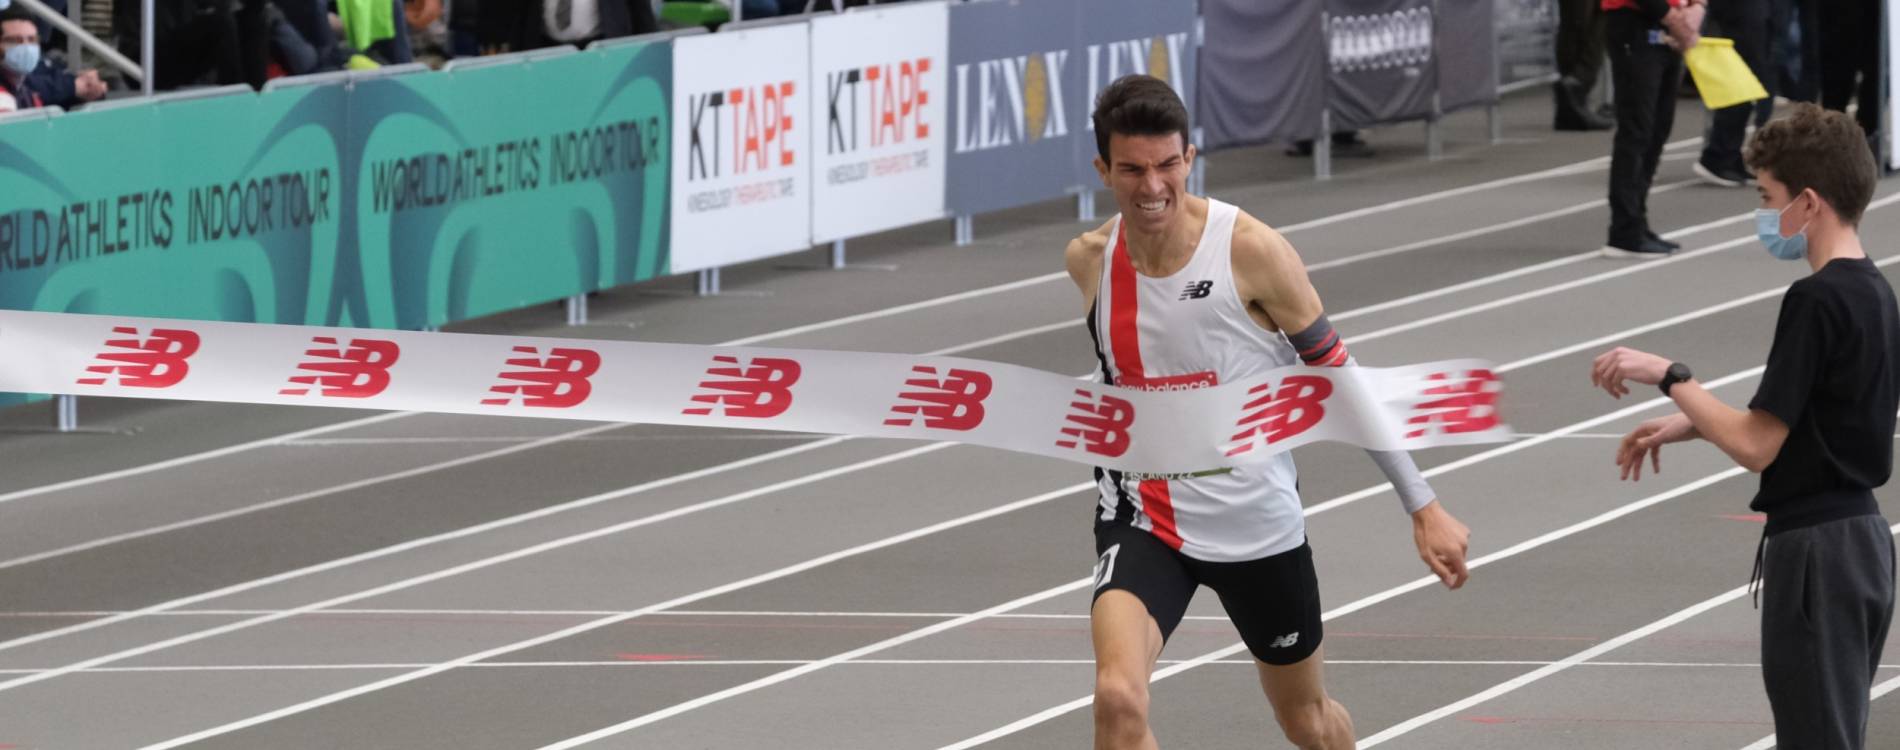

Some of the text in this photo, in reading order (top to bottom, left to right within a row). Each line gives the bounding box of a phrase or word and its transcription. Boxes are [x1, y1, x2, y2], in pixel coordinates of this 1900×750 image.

[687, 90, 724, 181] KT
[728, 80, 796, 174] TAPE
[827, 57, 931, 154] KT TAPE
[955, 50, 1069, 154] LENOX
[371, 116, 660, 214] WORLD ATHLETICS INDOOR TOUR
[55, 188, 174, 264] ATHLETICS
[187, 177, 274, 245] INDOOR
[277, 167, 330, 228] TOUR
[76, 327, 200, 389] NB
[279, 336, 400, 399] NB
[480, 346, 601, 408] NB
[681, 356, 801, 419] NB
[883, 366, 992, 431] NB
[1055, 388, 1135, 458] NB
[1224, 374, 1333, 457] NB
